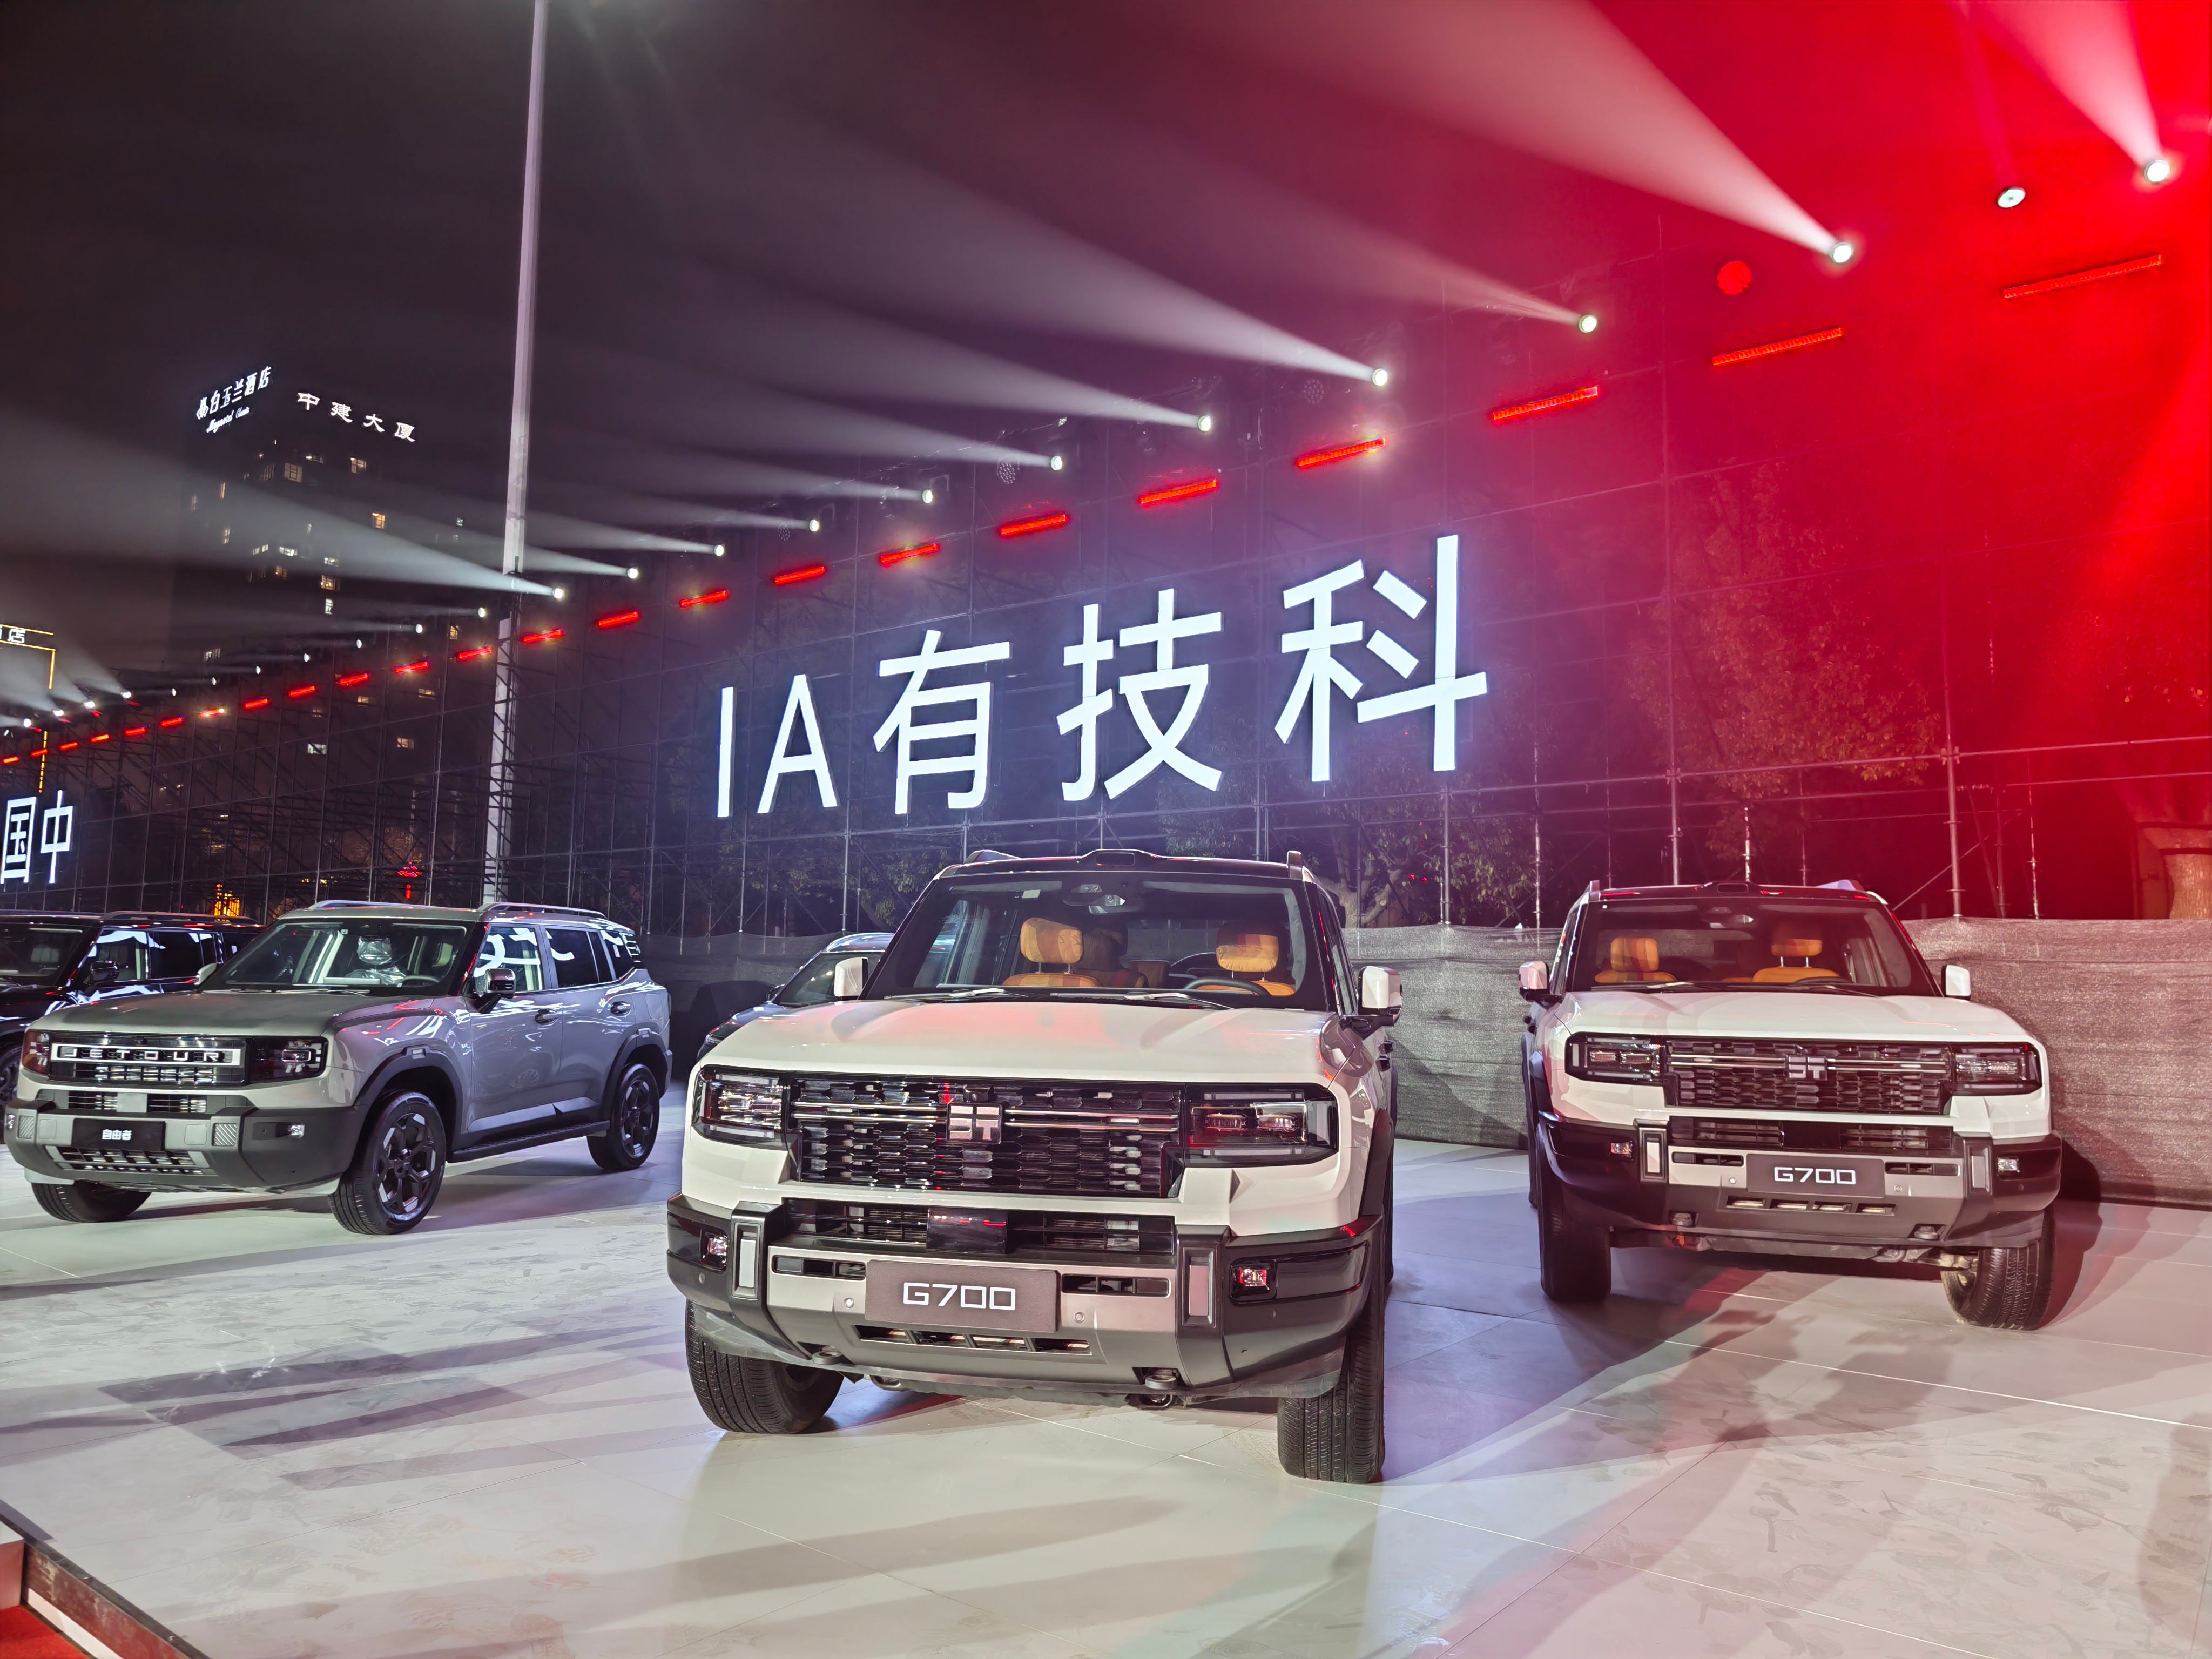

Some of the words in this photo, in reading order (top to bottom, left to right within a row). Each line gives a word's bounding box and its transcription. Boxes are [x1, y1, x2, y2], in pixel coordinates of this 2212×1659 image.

[297, 393, 415, 442] 中建大厦
[0, 626, 26, 643] 店
[64, 1048, 219, 1062] JETOUR
[102, 1129, 132, 1141] 自由者
[1773, 1166, 1856, 1185] G700
[903, 1282, 1016, 1311] G700
